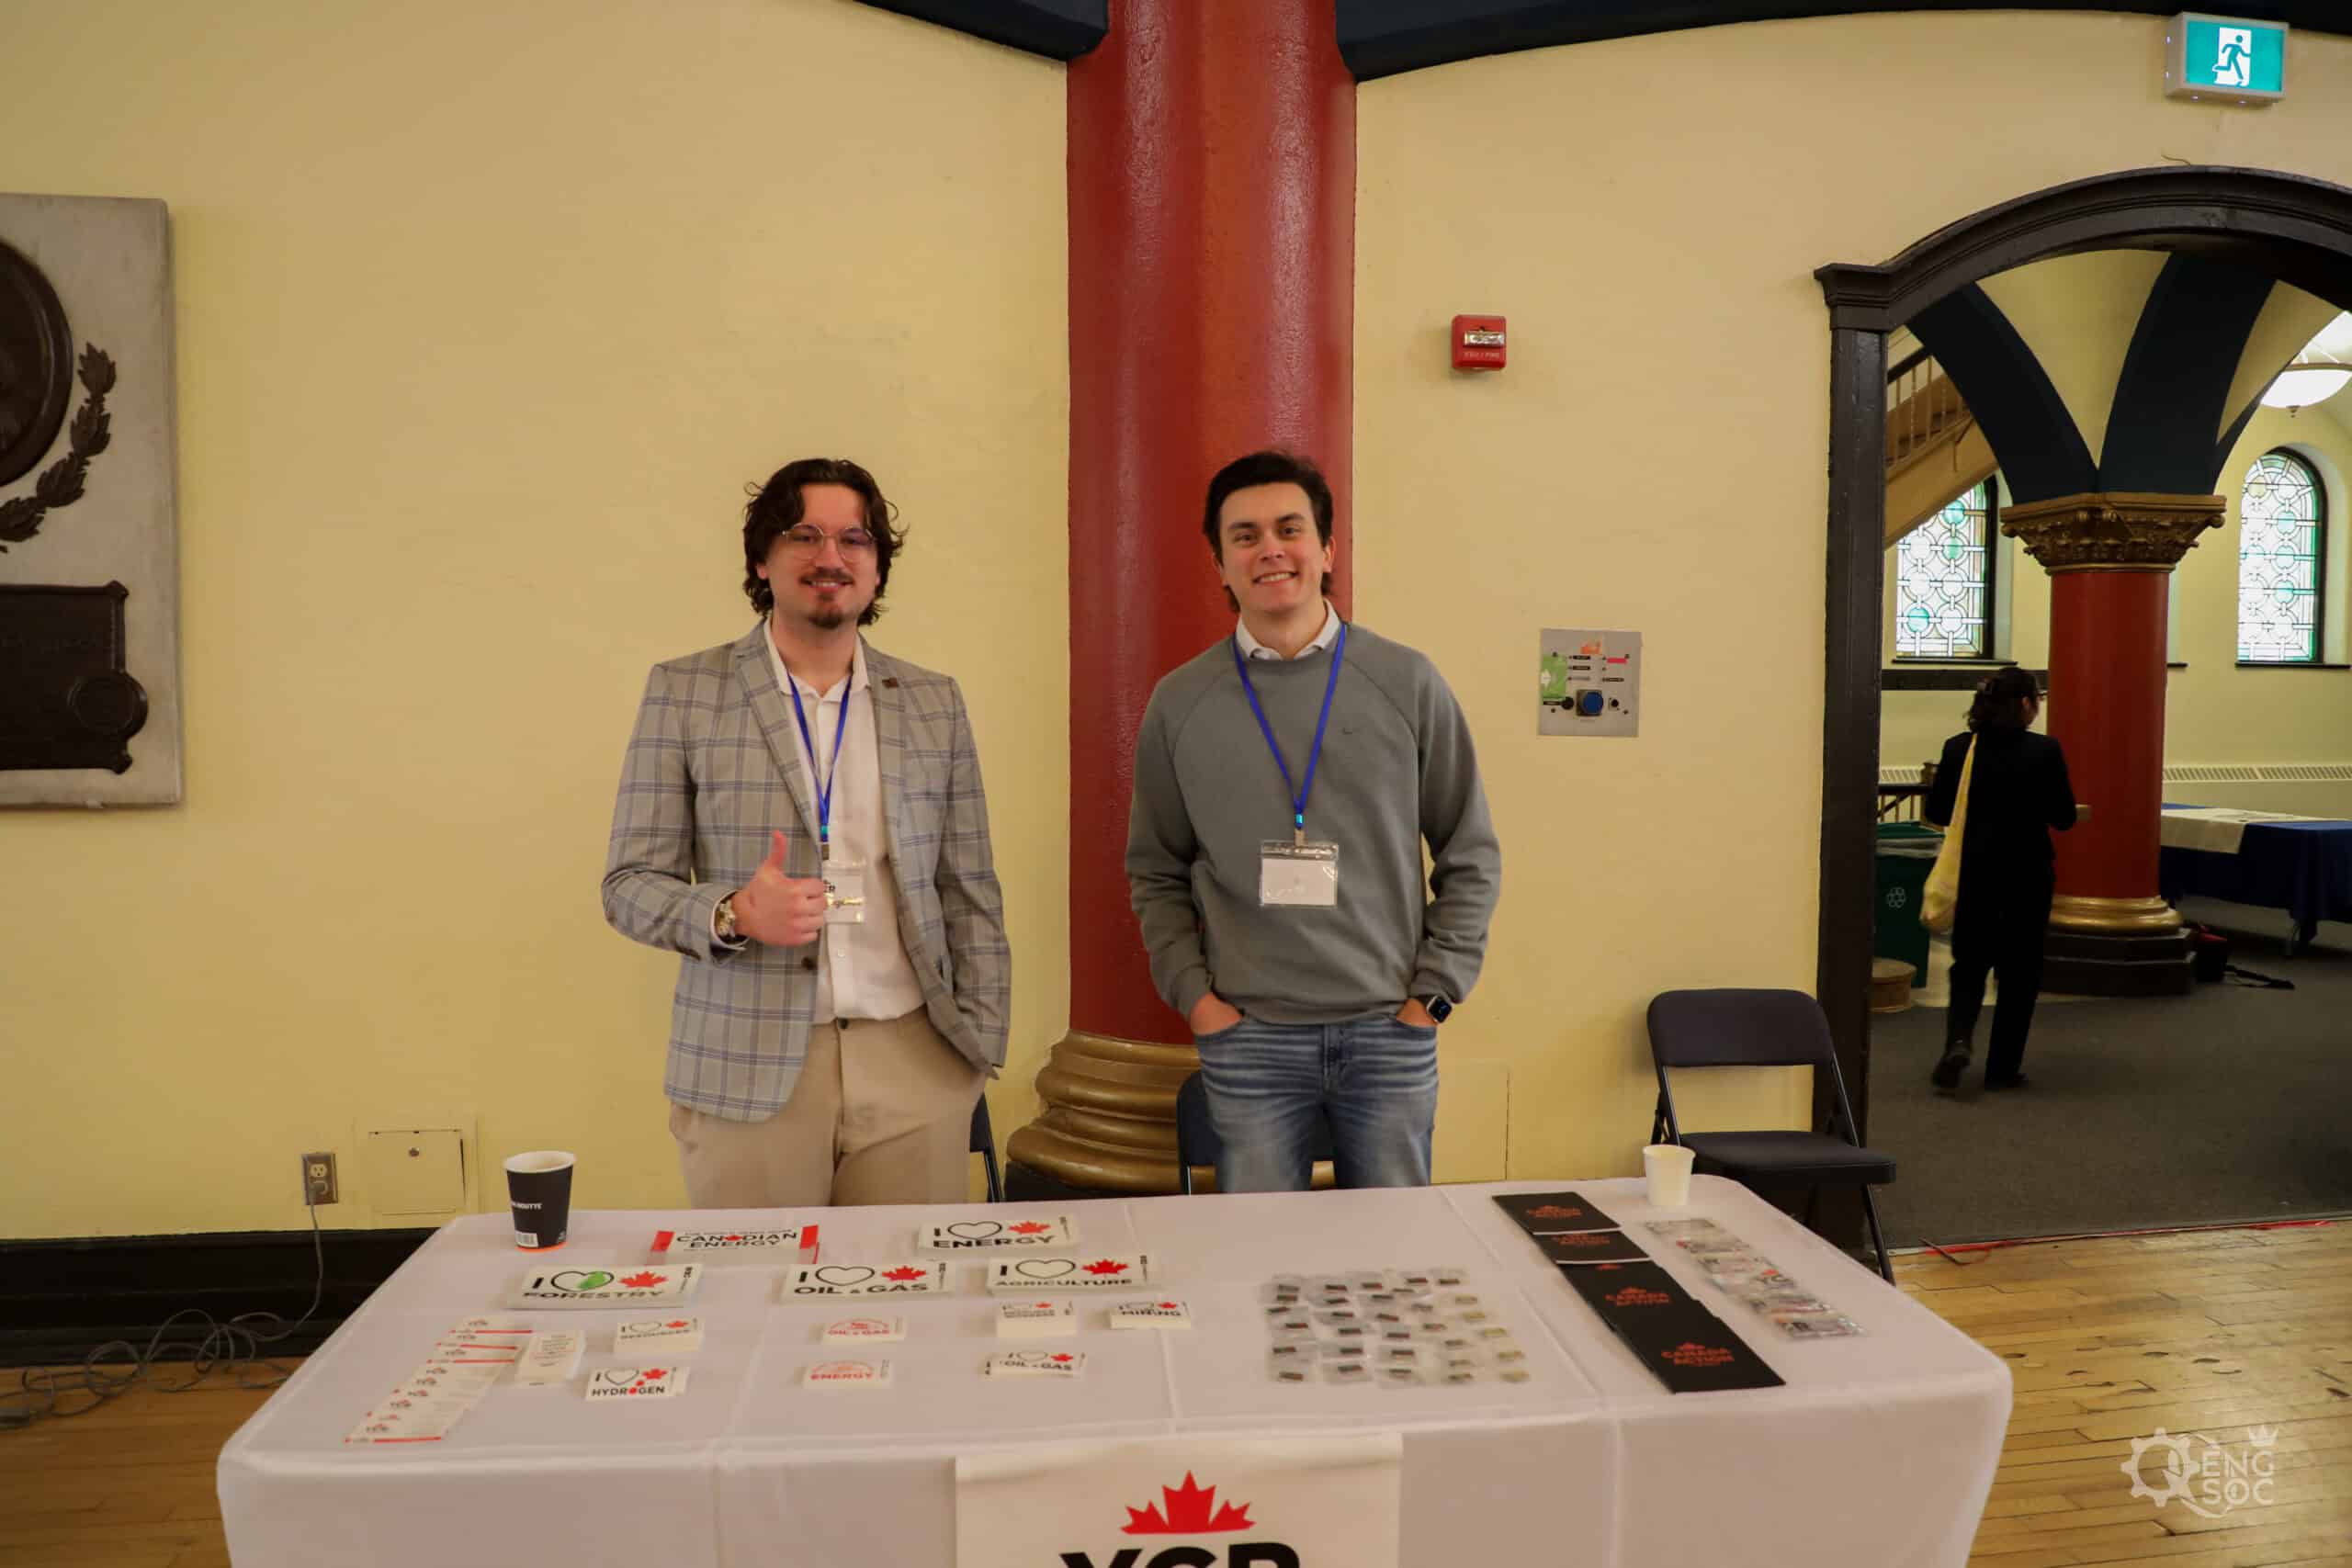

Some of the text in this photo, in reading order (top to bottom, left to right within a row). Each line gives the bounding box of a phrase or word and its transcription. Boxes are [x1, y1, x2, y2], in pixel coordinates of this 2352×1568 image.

[934, 1227, 941, 1236] I
[933, 1235, 1056, 1248] ENERGY
[1000, 1265, 1008, 1276] I
[798, 1271, 808, 1282] I
[532, 1277, 544, 1289] I
[866, 1284, 927, 1292] GAS
[523, 1291, 663, 1299] FORESTRY
